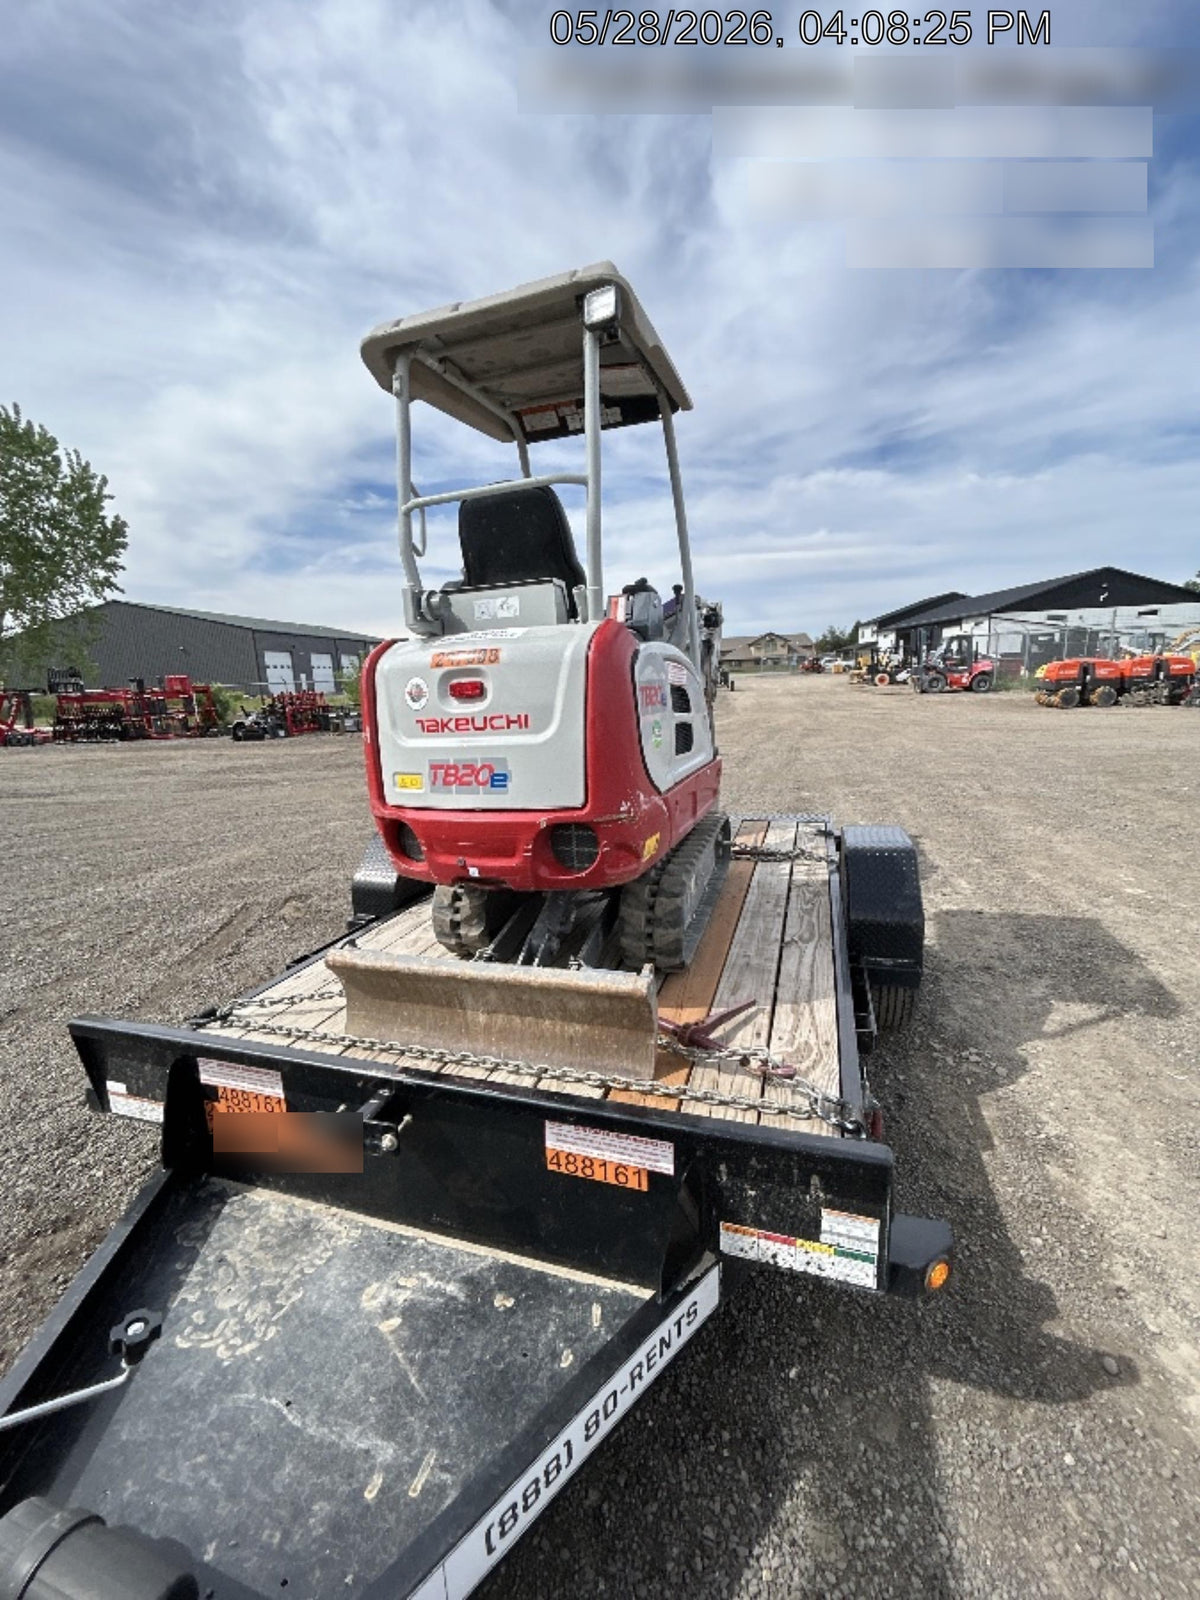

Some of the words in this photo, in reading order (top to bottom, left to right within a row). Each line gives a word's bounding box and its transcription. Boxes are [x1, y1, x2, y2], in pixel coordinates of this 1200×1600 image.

[219, 1086, 284, 1113] 488161
[549, 1151, 643, 1189] 488161
[484, 1439, 574, 1556] (888)
[584, 1300, 699, 1443] 80-RENTS
